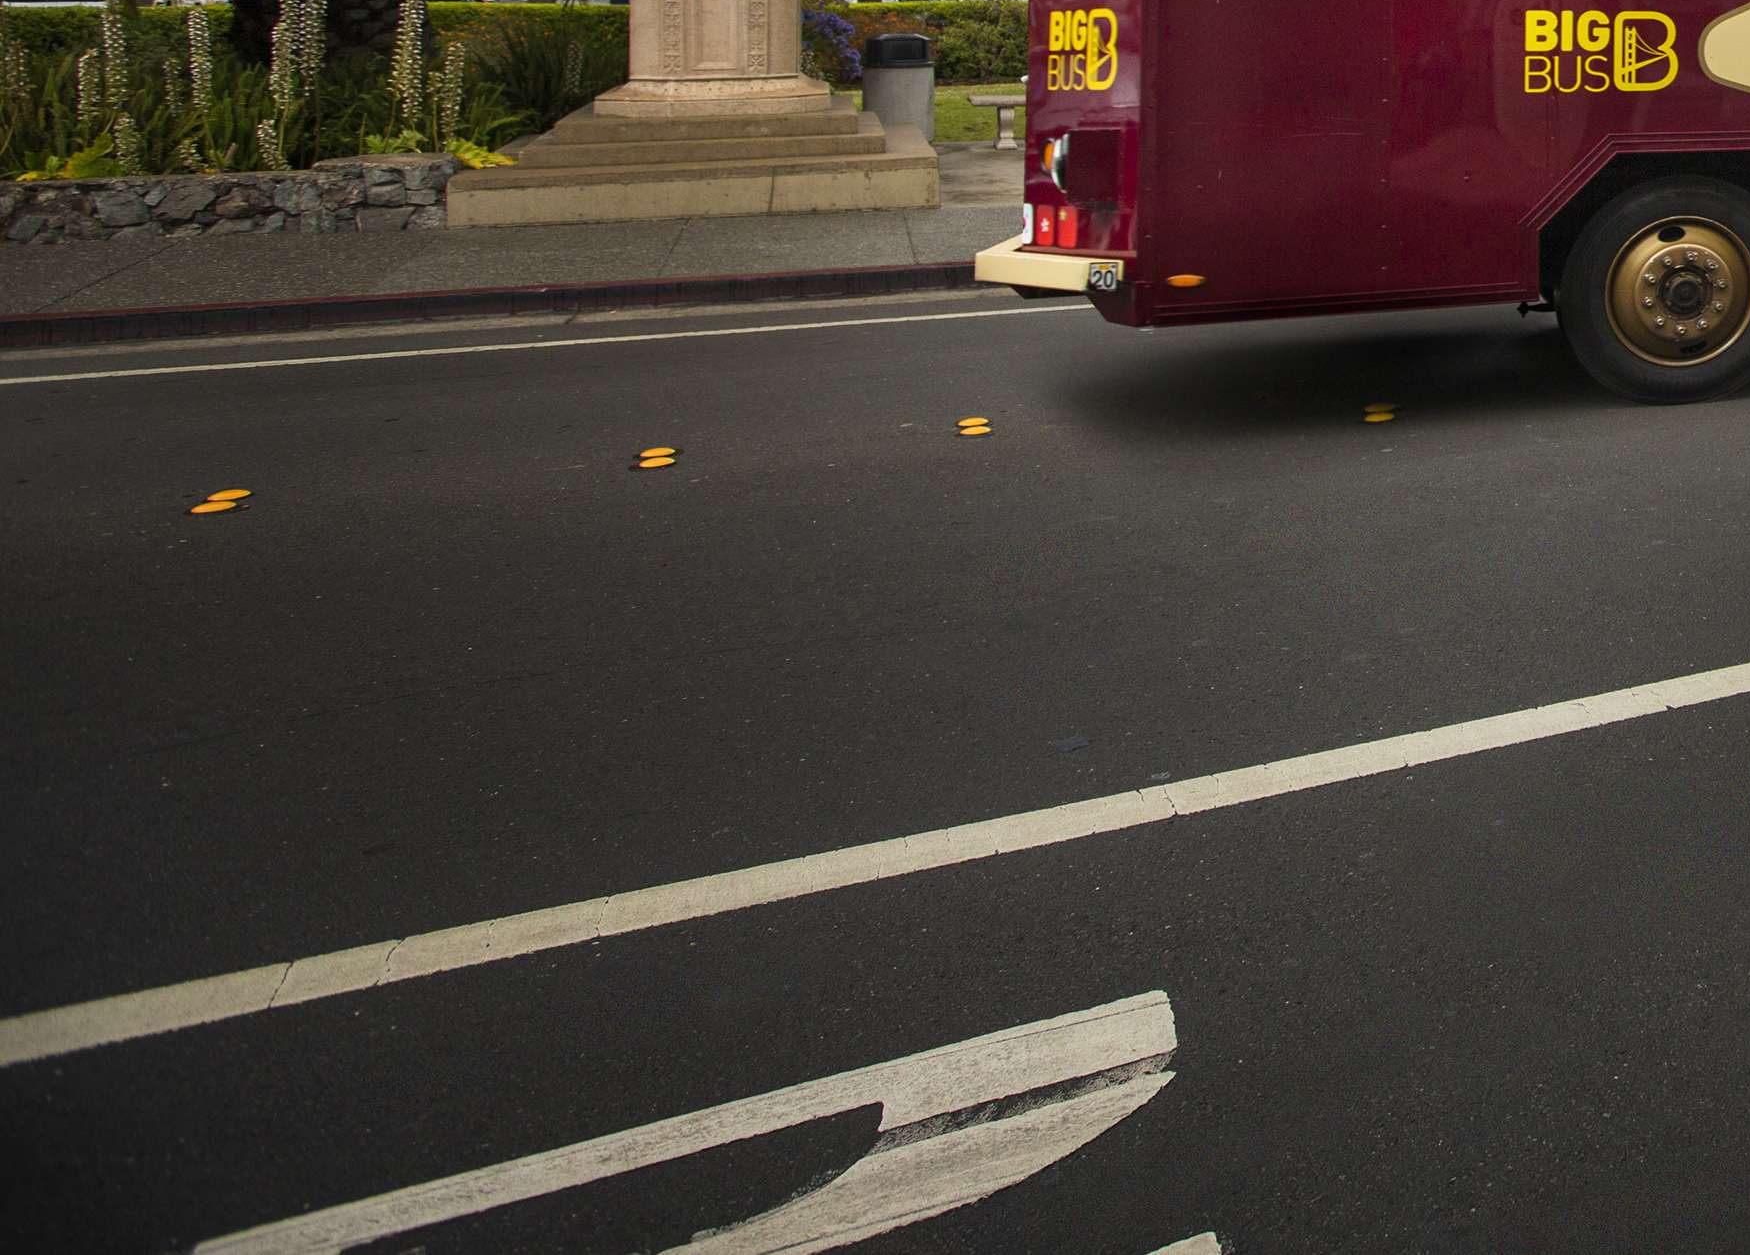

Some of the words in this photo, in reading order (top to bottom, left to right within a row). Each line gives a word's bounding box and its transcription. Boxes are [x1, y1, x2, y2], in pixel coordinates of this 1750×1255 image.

[1049, 9, 1088, 51] BIG
[1525, 10, 1611, 52] BIG
[1047, 54, 1085, 90] BUS
[1525, 56, 1610, 93] BUS
[1093, 270, 1114, 288] 20
